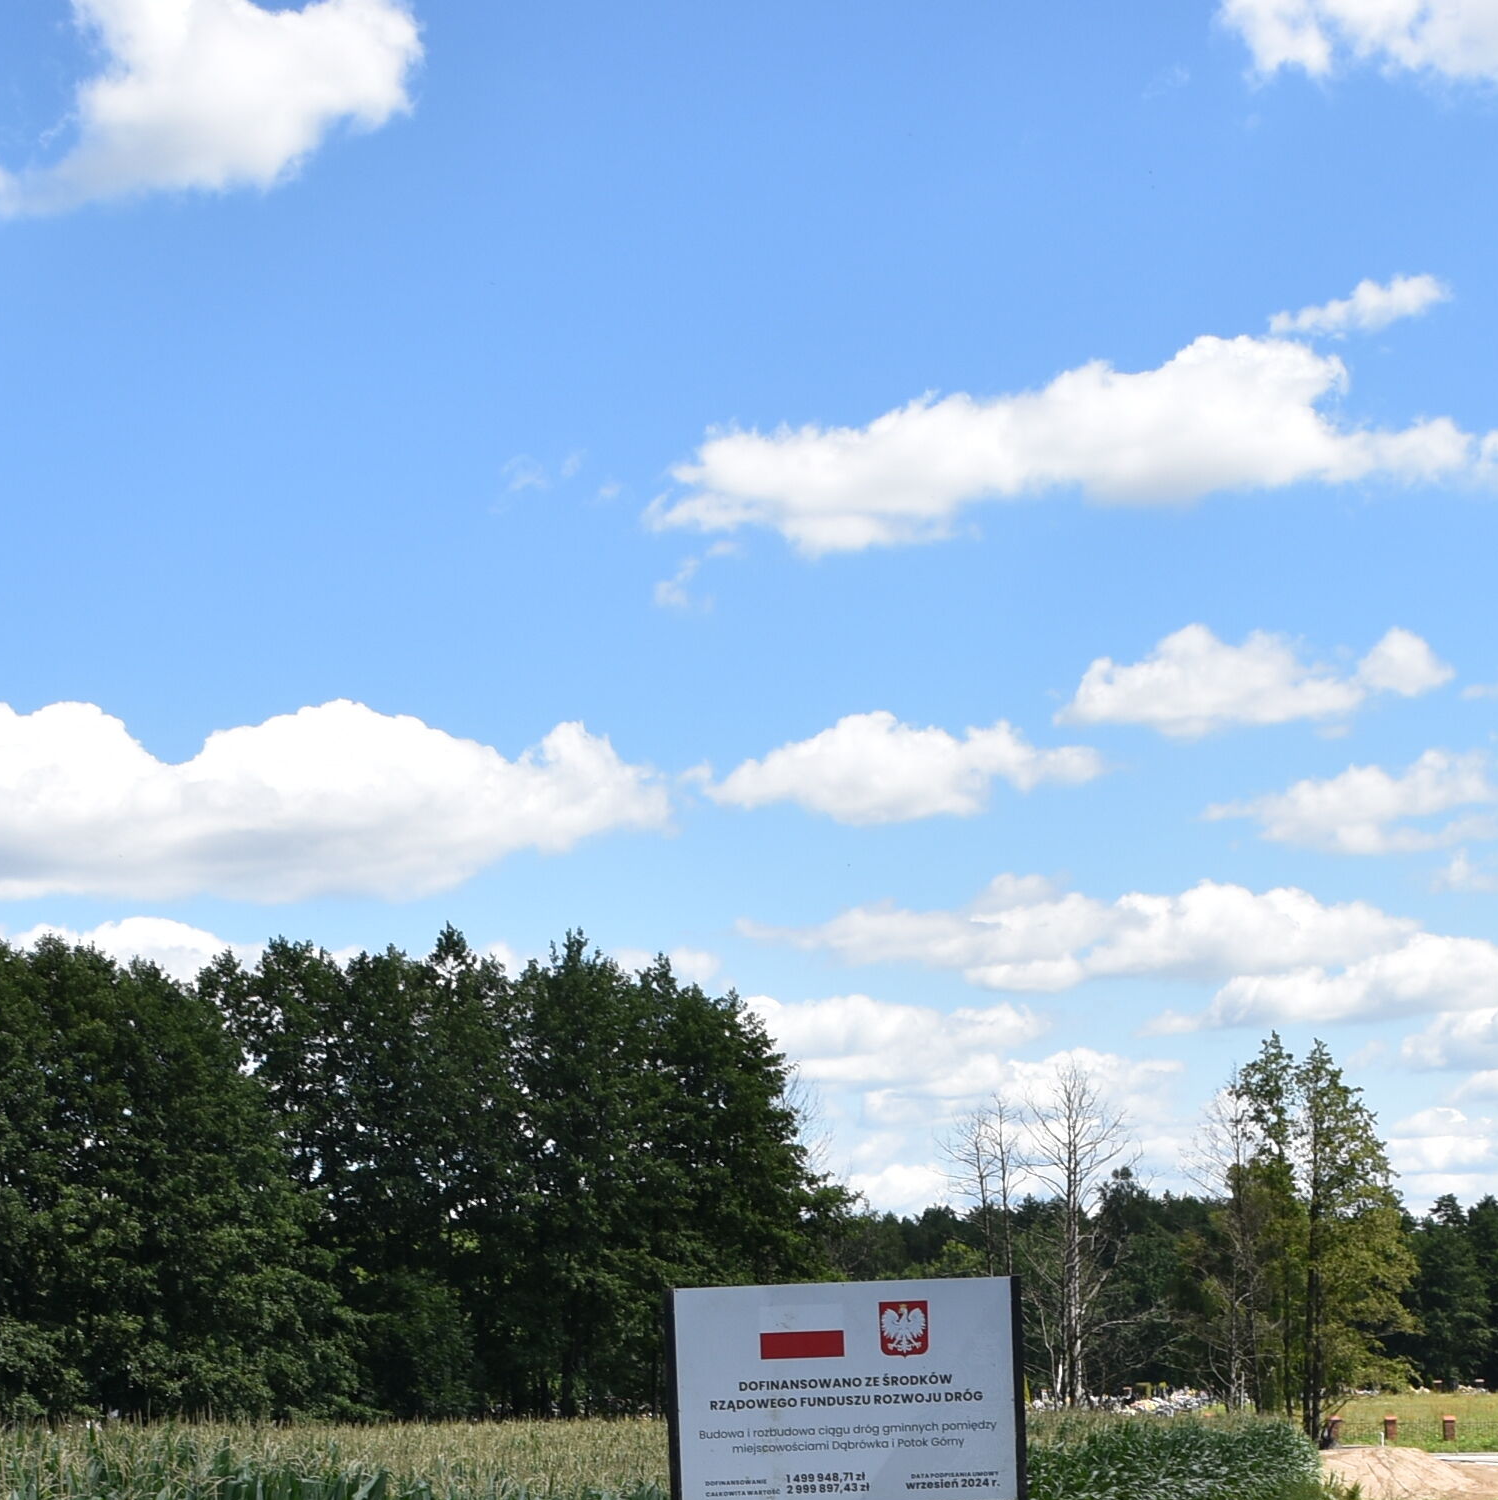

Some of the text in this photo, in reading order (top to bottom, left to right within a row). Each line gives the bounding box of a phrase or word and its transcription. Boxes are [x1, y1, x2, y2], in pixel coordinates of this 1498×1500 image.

[739, 1372, 953, 1392] DOFINANSOWANO ZE ŚRODKÓW
[709, 1389, 984, 1412] RZĄDOWEGO FUNDUSZU ROZWOJU DRÓG
[699, 1429, 745, 1440] Budowa
[753, 1426, 816, 1438] rozbudowa
[818, 1425, 851, 1438] ciągu
[853, 1424, 880, 1436] dróg
[883, 1422, 939, 1435] gminnych
[941, 1420, 997, 1434] pomiędzy
[732, 1441, 830, 1455] miejscowościami
[832, 1438, 889, 1452] Dąbrówka
[897, 1437, 929, 1448] Potok
[931, 1436, 965, 1449] Górny
[786, 1474, 790, 1483] 1
[793, 1473, 815, 1483] 499
[817, 1472, 854, 1483] 948,71
[855, 1471, 866, 1481] zł
[905, 1477, 1001, 1490] wrzesień 2024 r.
[786, 1485, 793, 1494] 2
[795, 1484, 817, 1494] 999
[819, 1483, 858, 1495] 897,43
[860, 1482, 870, 1492] zł
